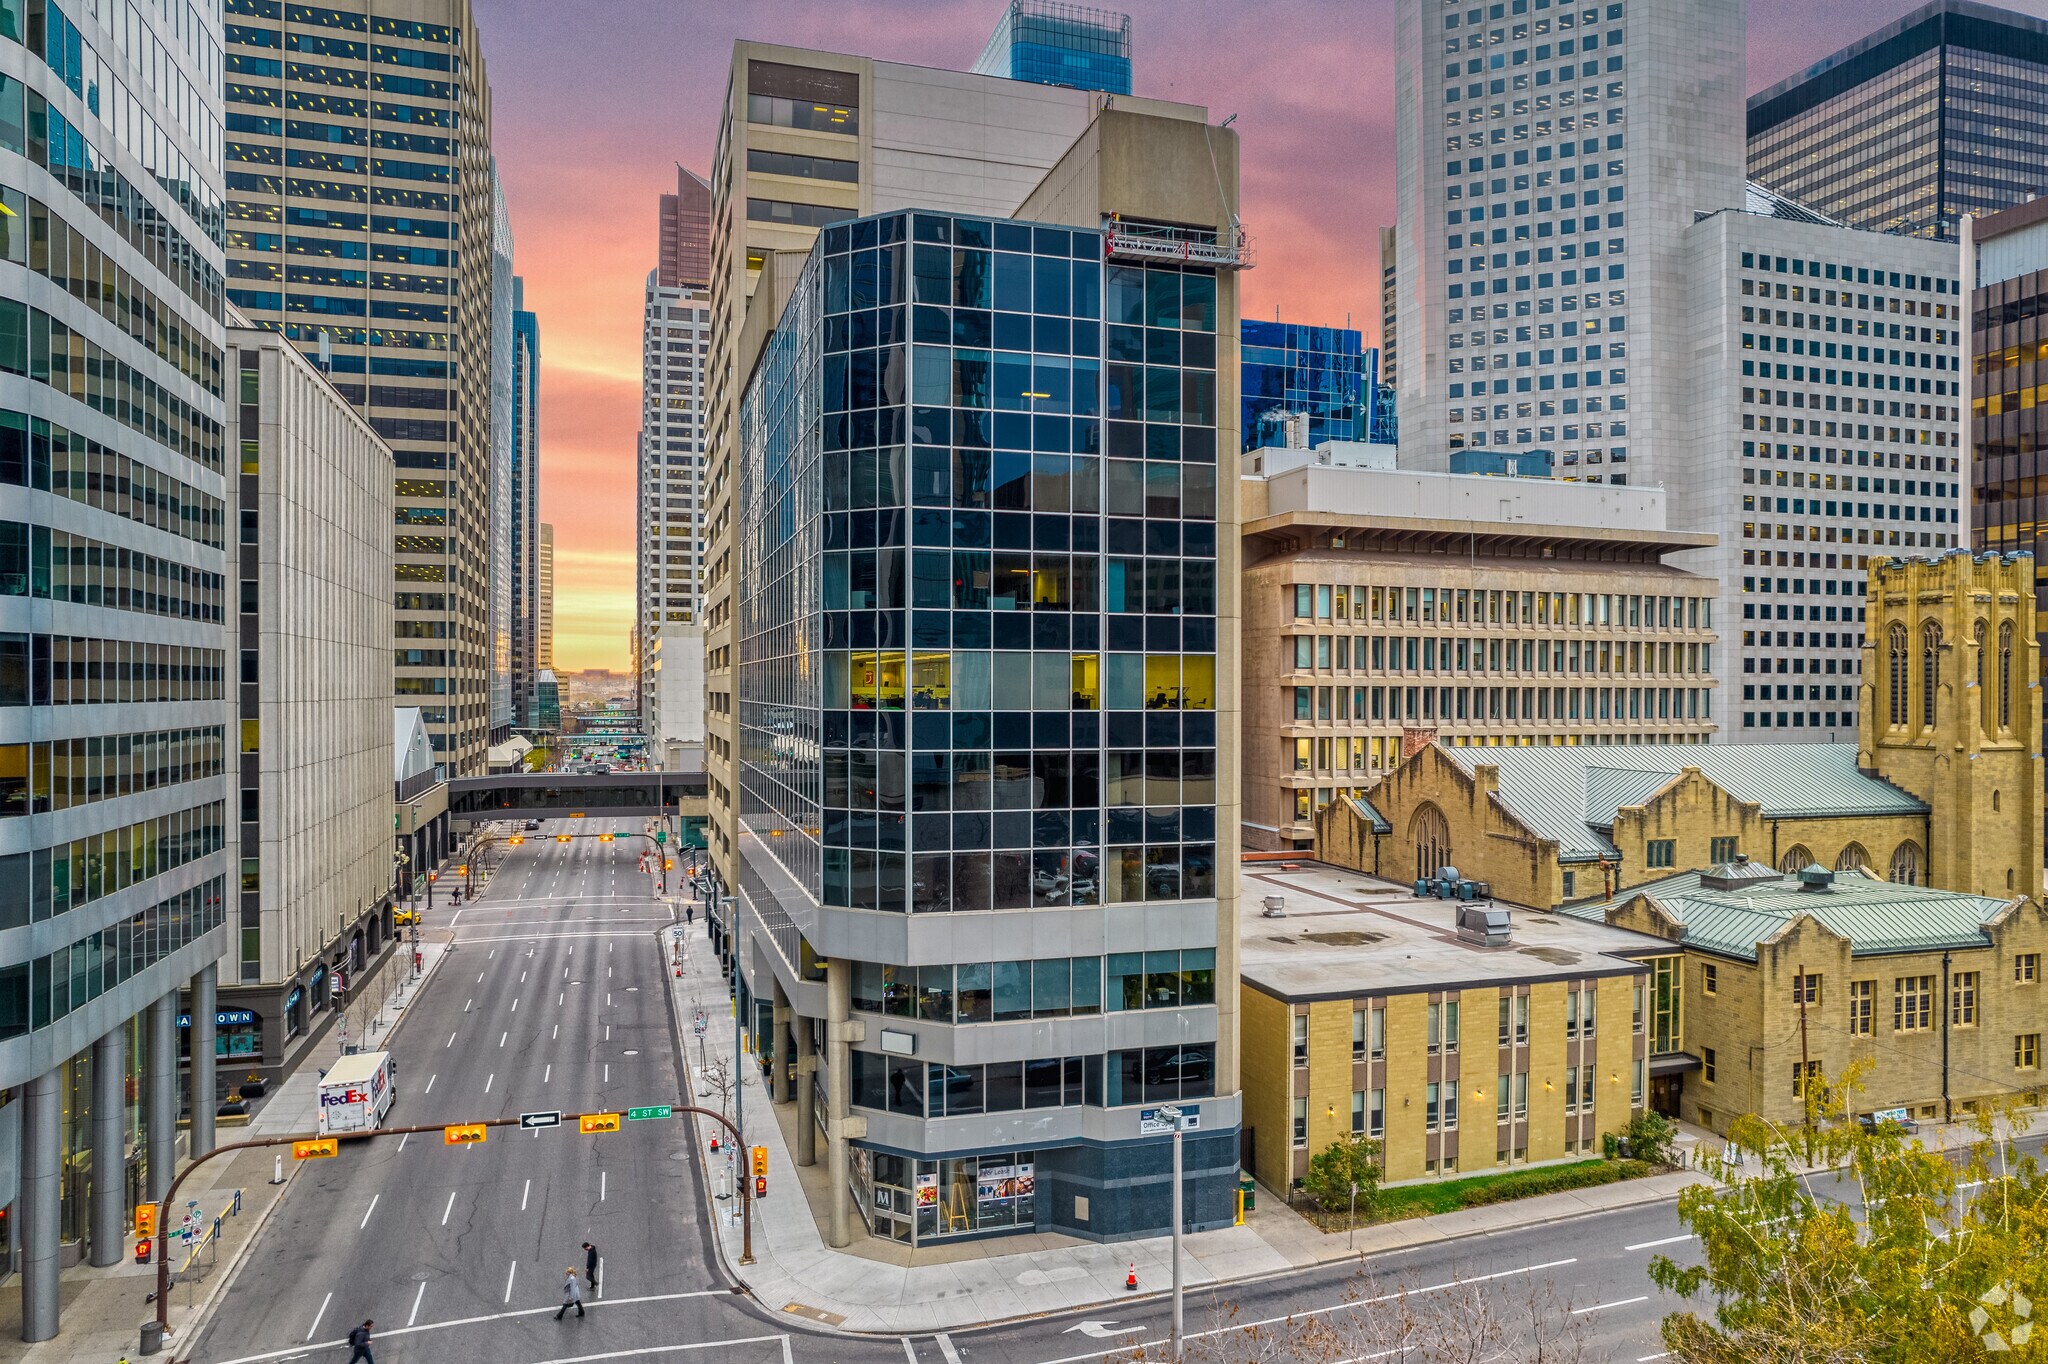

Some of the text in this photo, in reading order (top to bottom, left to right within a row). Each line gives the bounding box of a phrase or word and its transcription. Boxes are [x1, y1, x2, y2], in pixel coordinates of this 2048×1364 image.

[217, 1013, 250, 1023] OWN
[320, 1090, 368, 1107] FedEx
[642, 1109, 652, 1117] ST
[658, 1108, 669, 1116] SW
[877, 1190, 889, 1204] M
